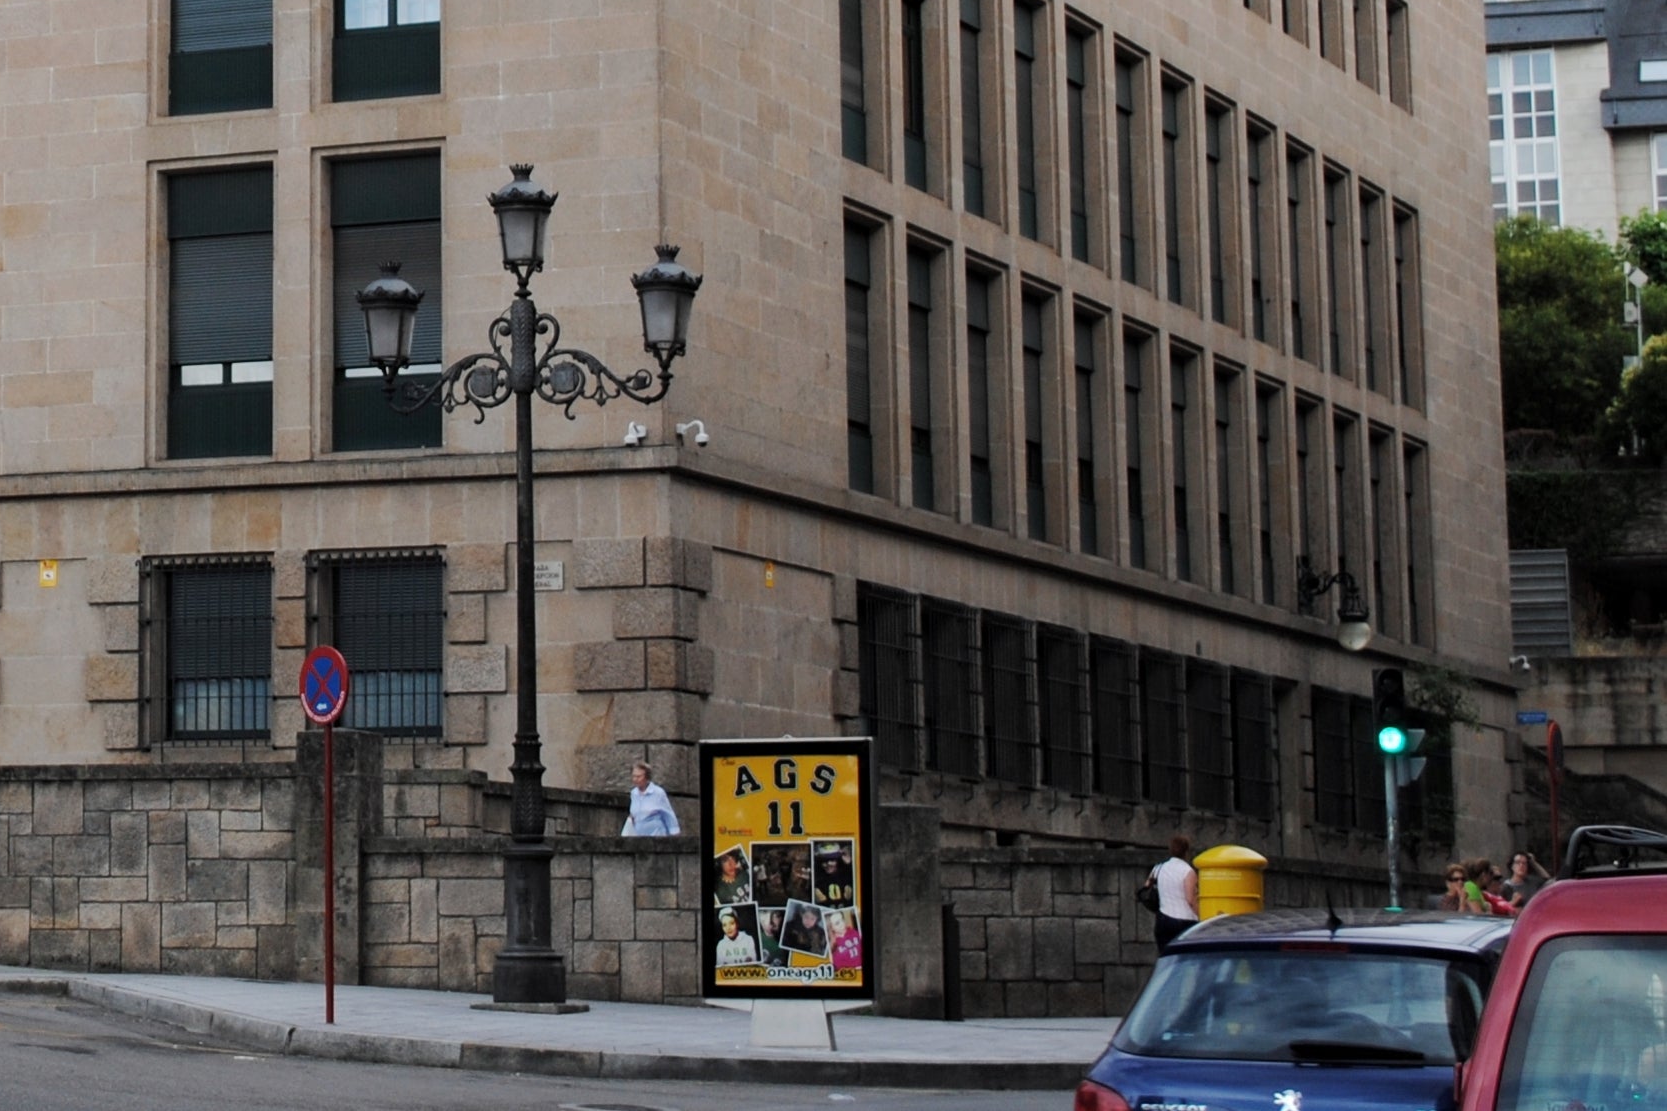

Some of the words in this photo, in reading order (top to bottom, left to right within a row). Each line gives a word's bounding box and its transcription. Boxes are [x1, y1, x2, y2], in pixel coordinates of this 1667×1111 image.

[734, 757, 836, 797] AGS
[767, 800, 804, 835] 11
[721, 965, 856, 982] www.oneags11.es
